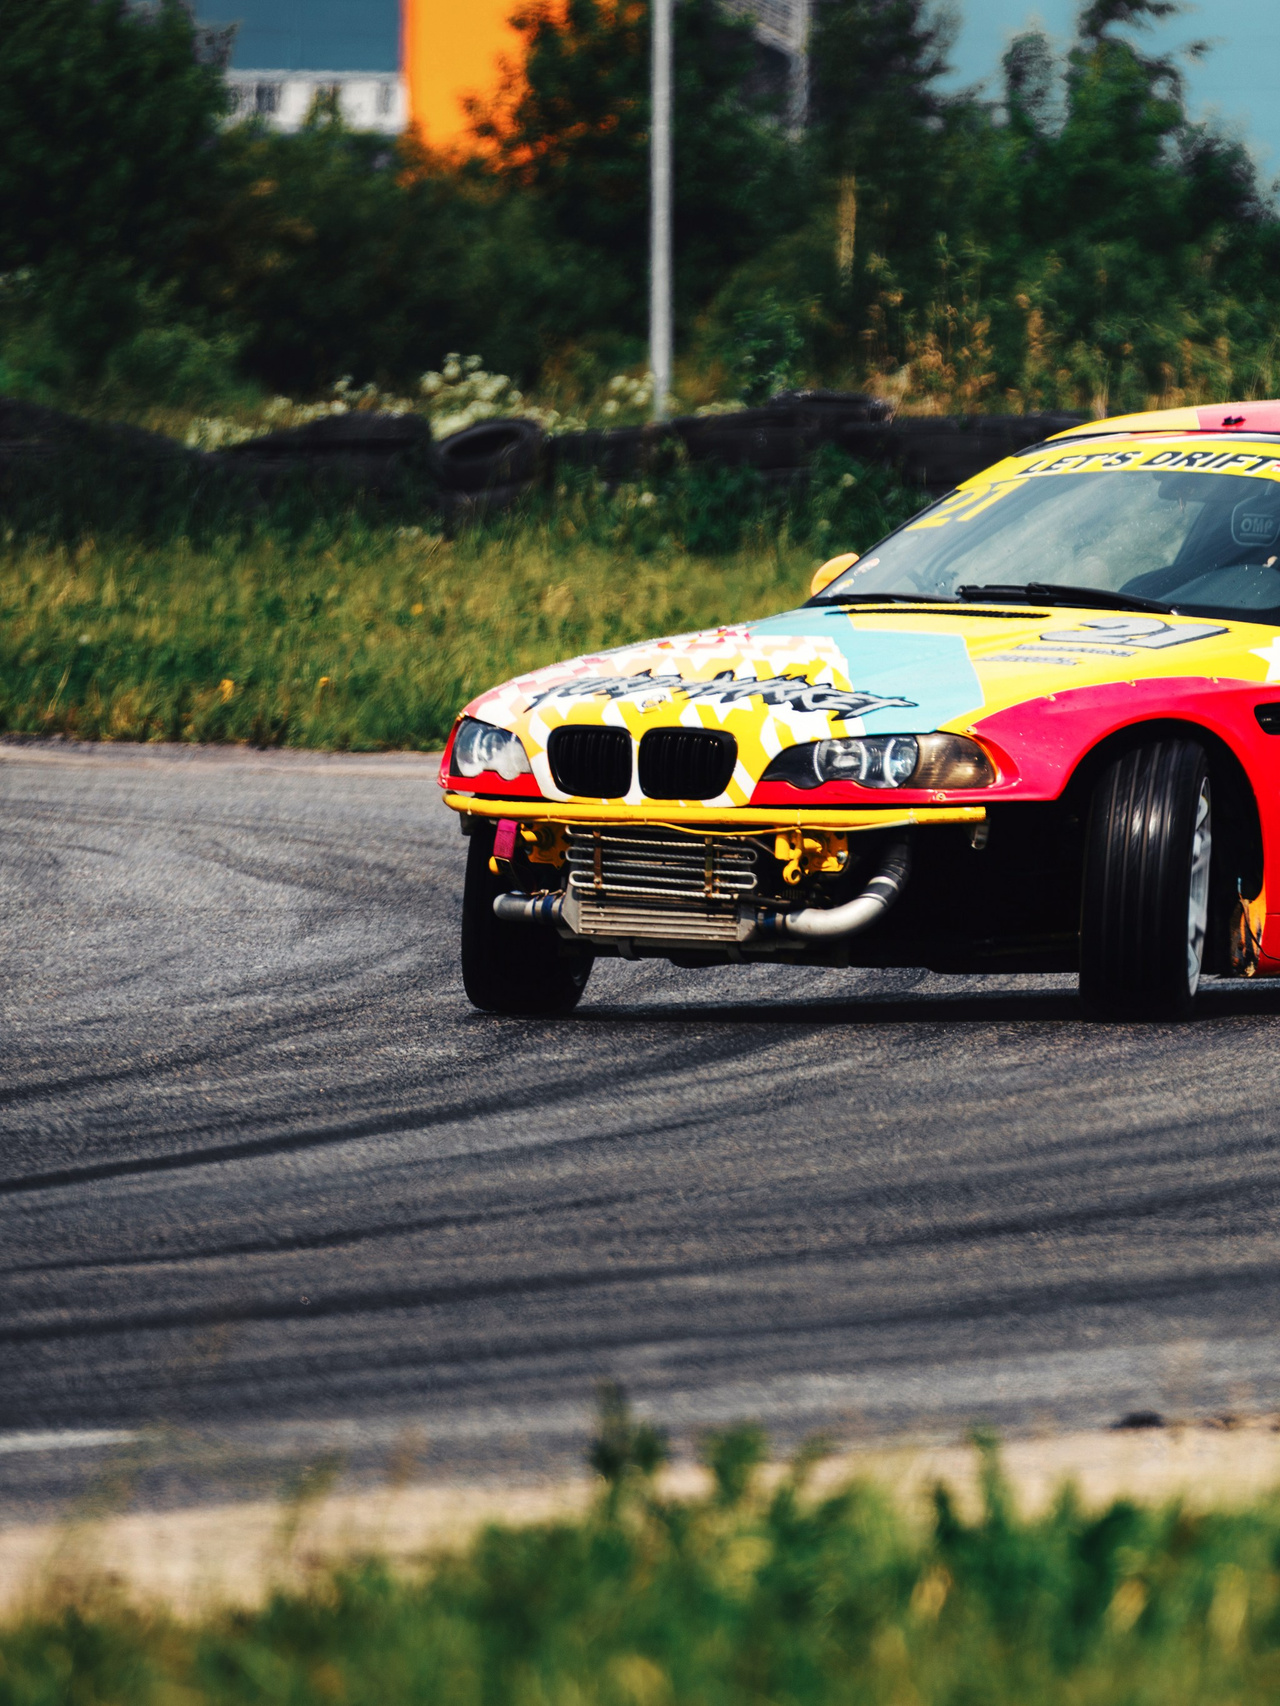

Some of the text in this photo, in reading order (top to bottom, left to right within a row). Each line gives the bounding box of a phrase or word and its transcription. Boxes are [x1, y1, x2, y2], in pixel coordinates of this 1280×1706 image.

[1014, 451, 1143, 478] LET'S
[904, 478, 1030, 532] 21
[1241, 517, 1274, 533] OMP
[1039, 616, 1231, 649] 21
